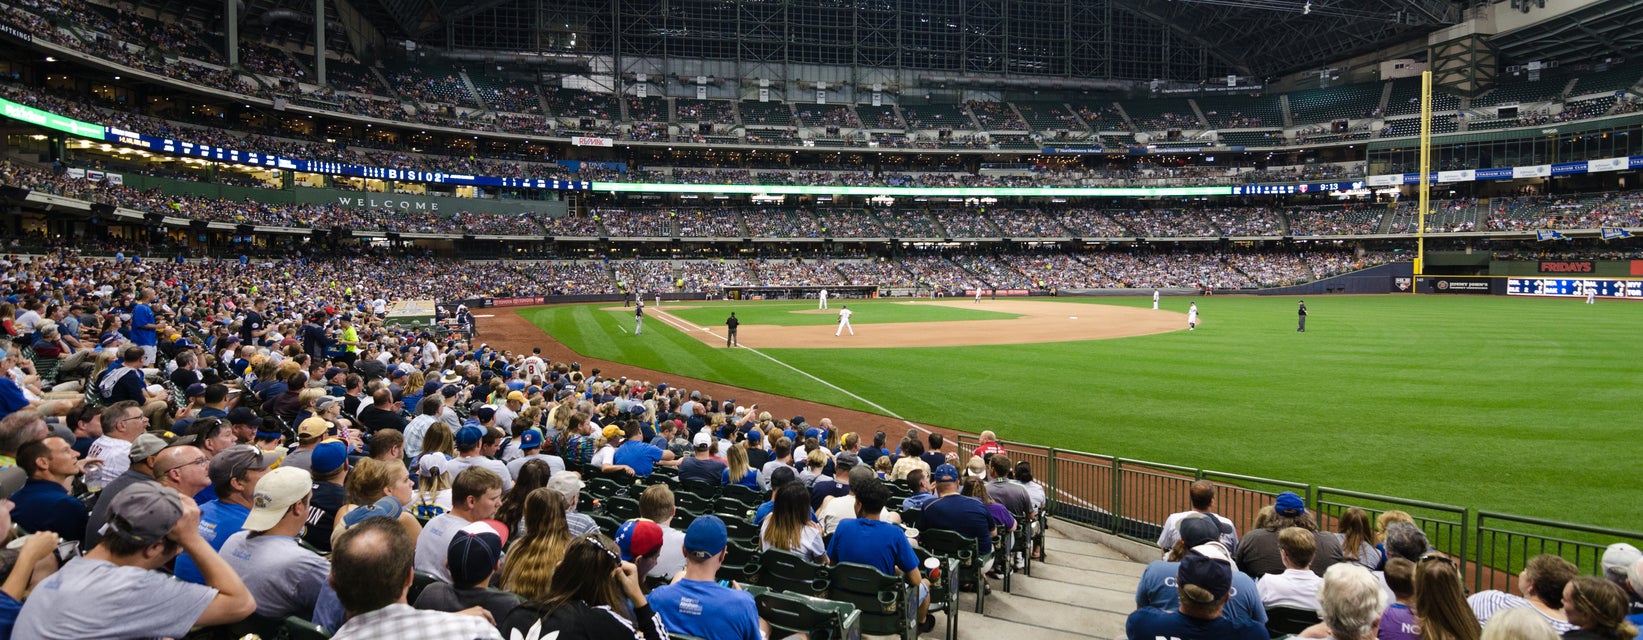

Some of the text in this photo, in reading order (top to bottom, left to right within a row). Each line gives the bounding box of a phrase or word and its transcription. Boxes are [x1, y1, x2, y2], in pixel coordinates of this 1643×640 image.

[1320, 183, 1339, 191] 9:13
[339, 197, 439, 210] WELCOME
[1541, 262, 1591, 272] FRIDAYS
[528, 365, 534, 374] 8
